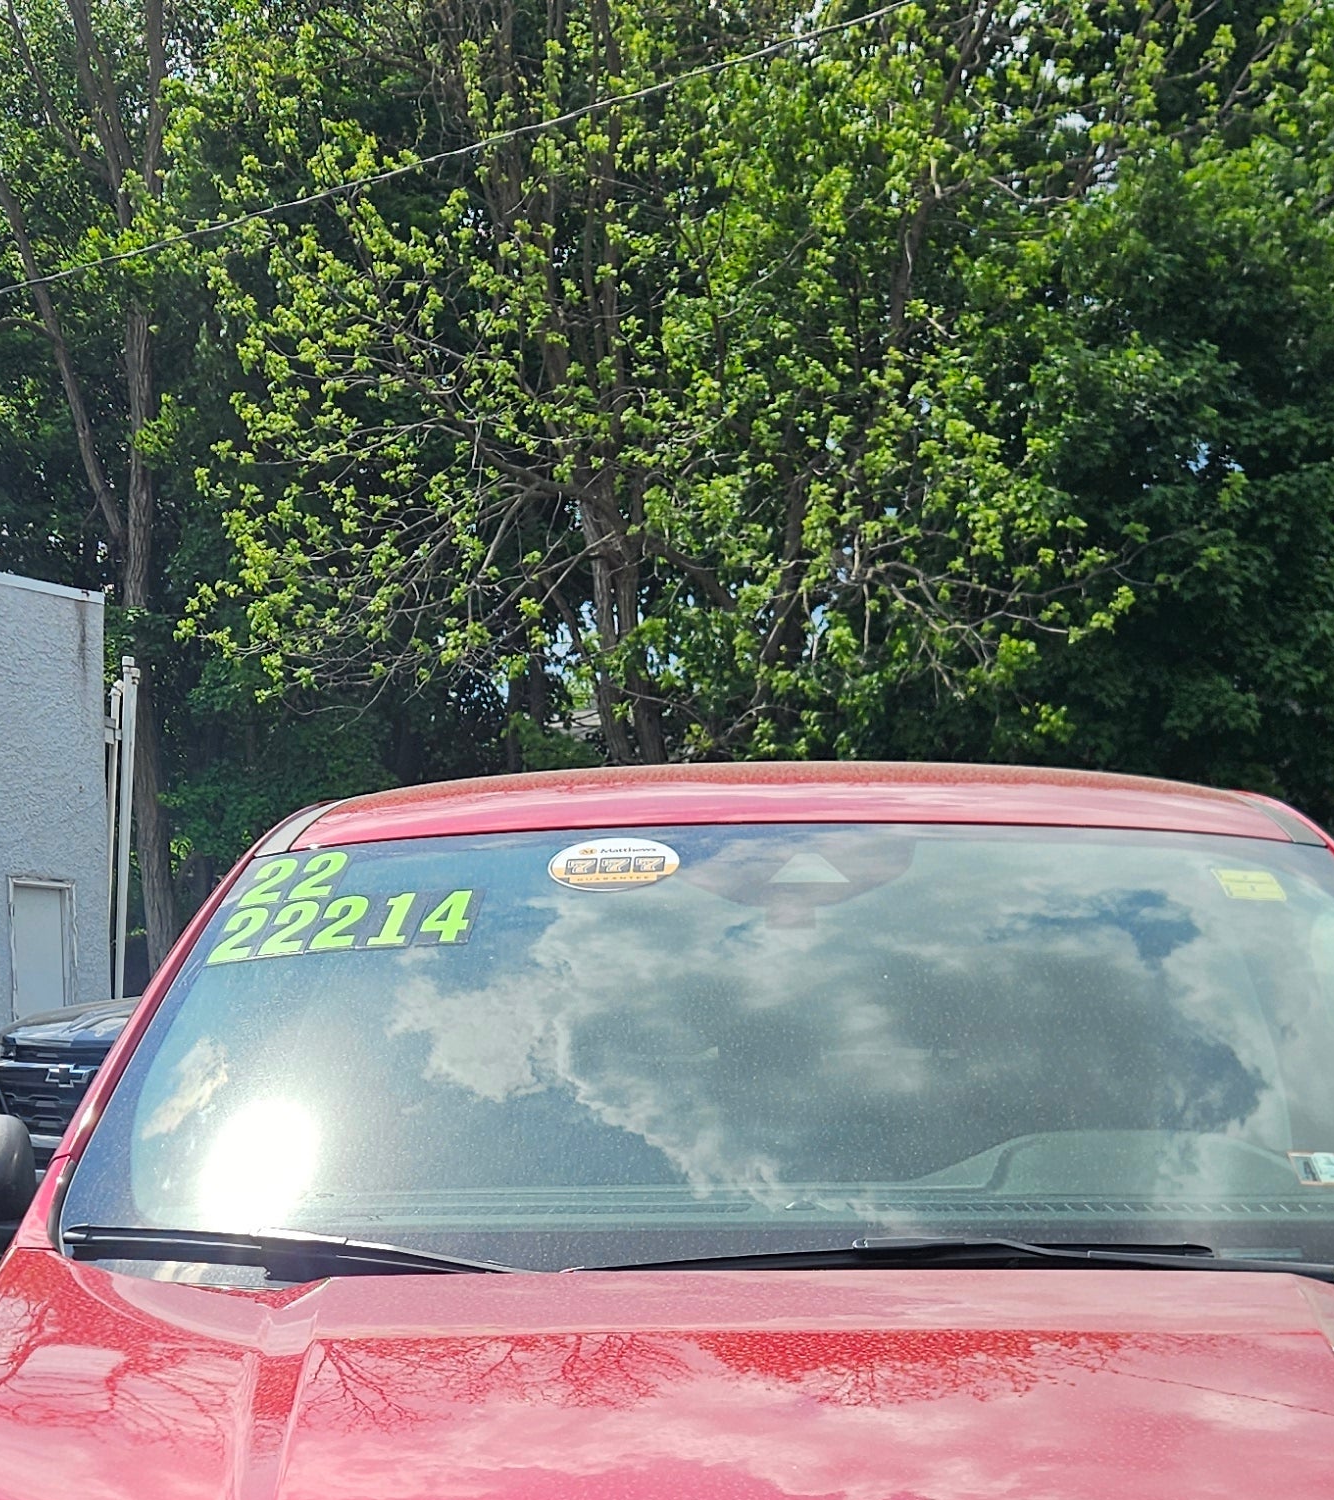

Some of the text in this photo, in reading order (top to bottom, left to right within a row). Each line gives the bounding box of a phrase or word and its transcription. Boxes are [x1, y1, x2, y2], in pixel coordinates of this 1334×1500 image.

[241, 851, 348, 902] 22
[599, 847, 657, 855] Matthews
[205, 889, 474, 965] 22214
